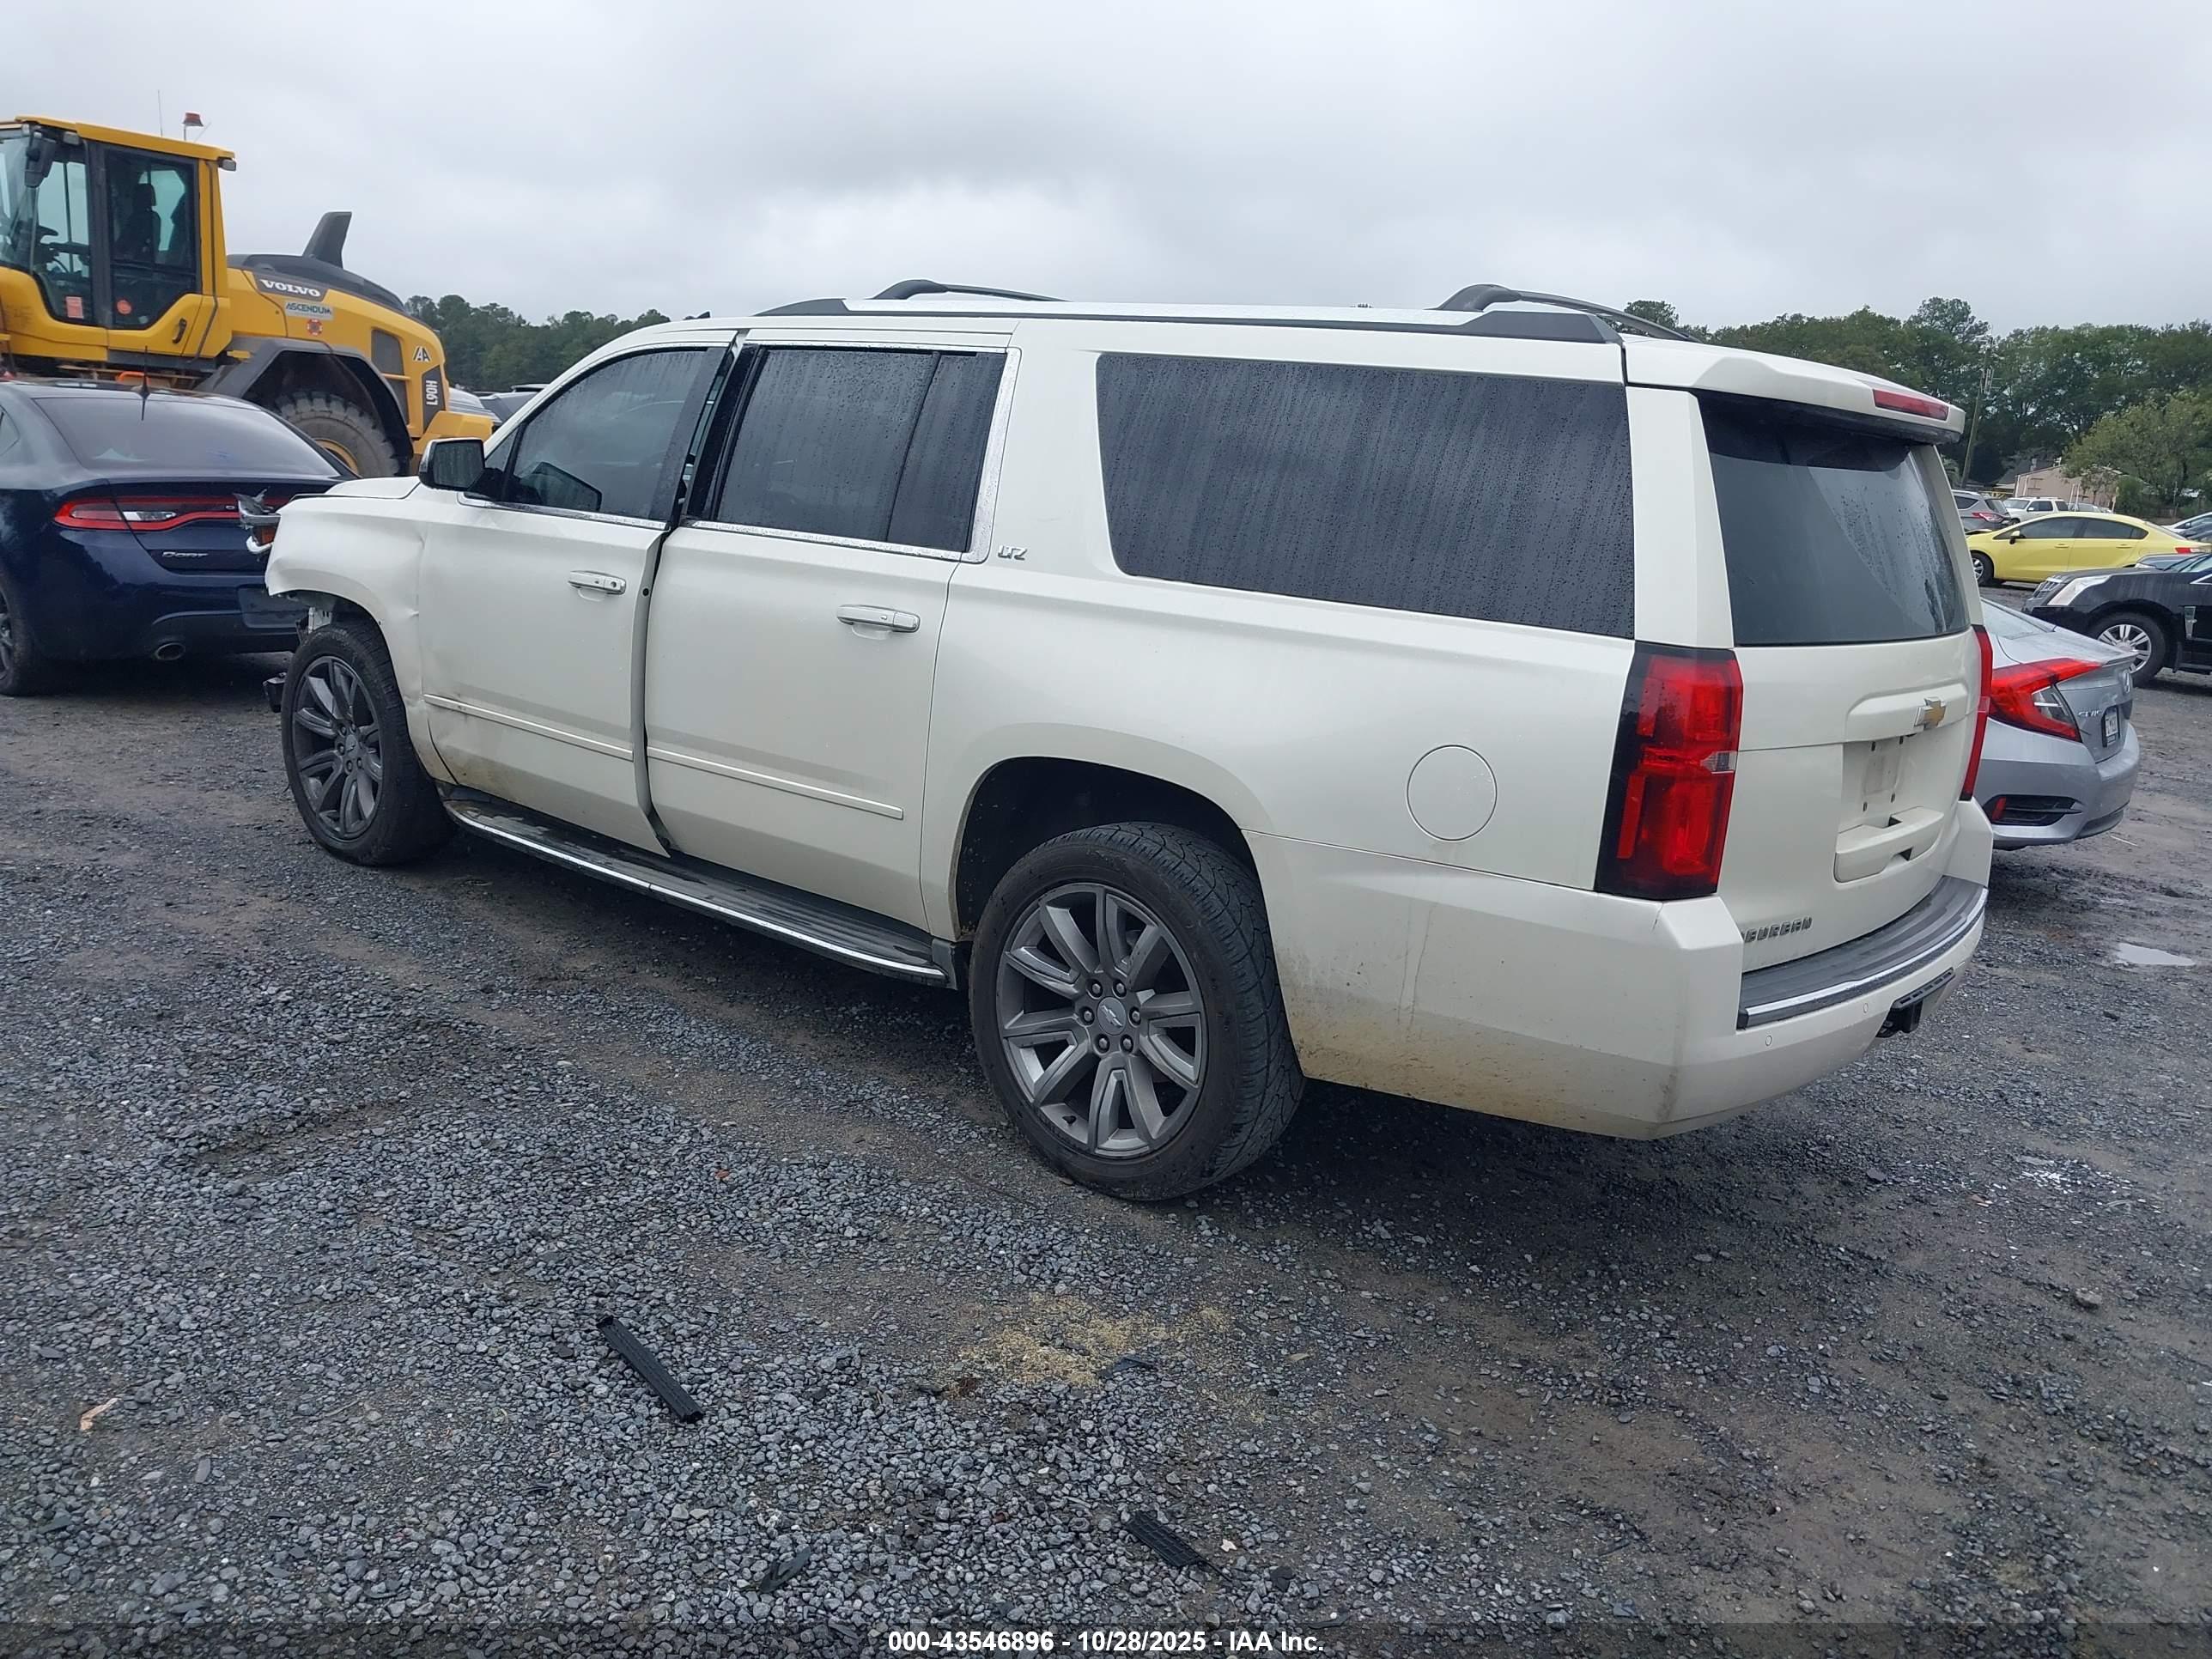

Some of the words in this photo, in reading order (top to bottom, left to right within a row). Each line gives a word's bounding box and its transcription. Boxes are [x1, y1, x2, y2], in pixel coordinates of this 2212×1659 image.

[260, 279, 321, 297] VOLVO
[286, 302, 331, 315] ASCENDUM
[426, 380, 439, 406] L90H
[997, 545, 1027, 561] LTZ
